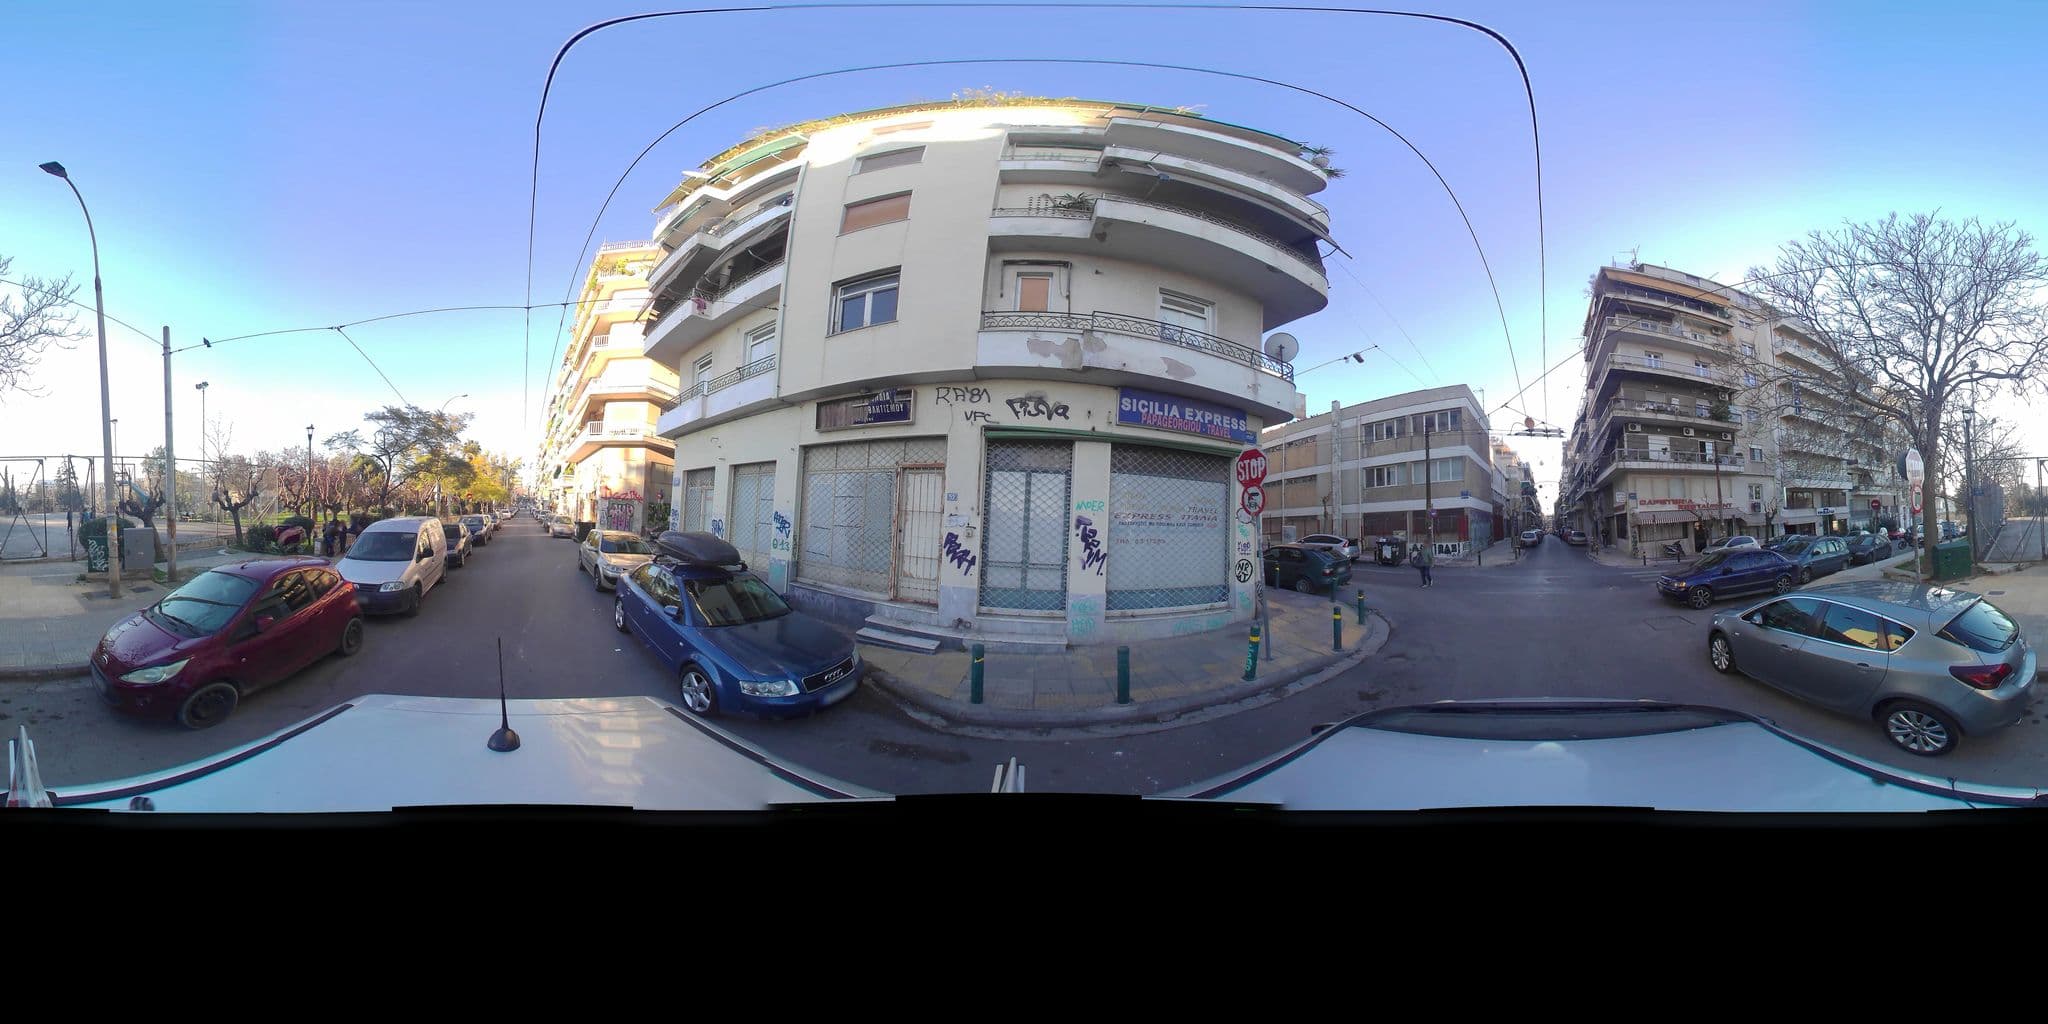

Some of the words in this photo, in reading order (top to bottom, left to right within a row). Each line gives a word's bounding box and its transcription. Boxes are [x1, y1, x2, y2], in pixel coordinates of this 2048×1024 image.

[1120, 397, 1180, 419] SICILIA
[1184, 407, 1247, 432] EXPRESS
[1141, 412, 1201, 432] PAPAGEORGIOU
[1207, 425, 1232, 439] TRAVEL
[1237, 456, 1266, 481] STOP
